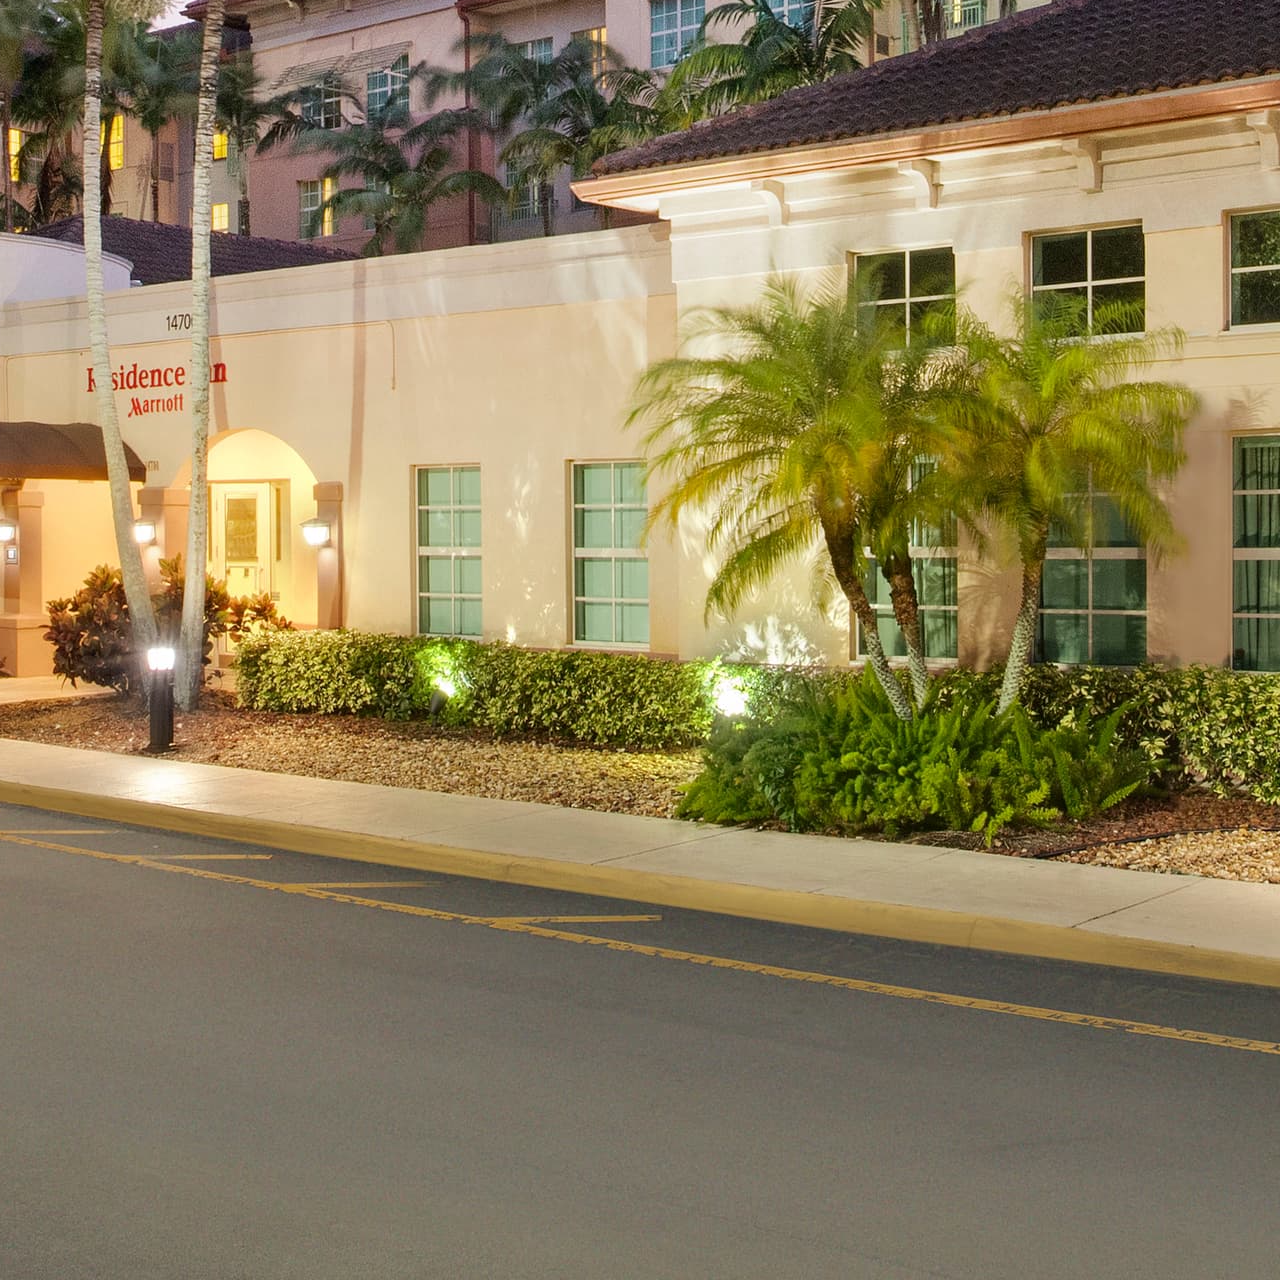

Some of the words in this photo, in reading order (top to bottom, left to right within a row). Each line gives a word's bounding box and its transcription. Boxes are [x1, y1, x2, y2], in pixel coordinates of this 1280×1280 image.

[166, 314, 193, 331] 1470
[86, 363, 186, 393] Rsidence
[128, 393, 184, 418] Marriott
